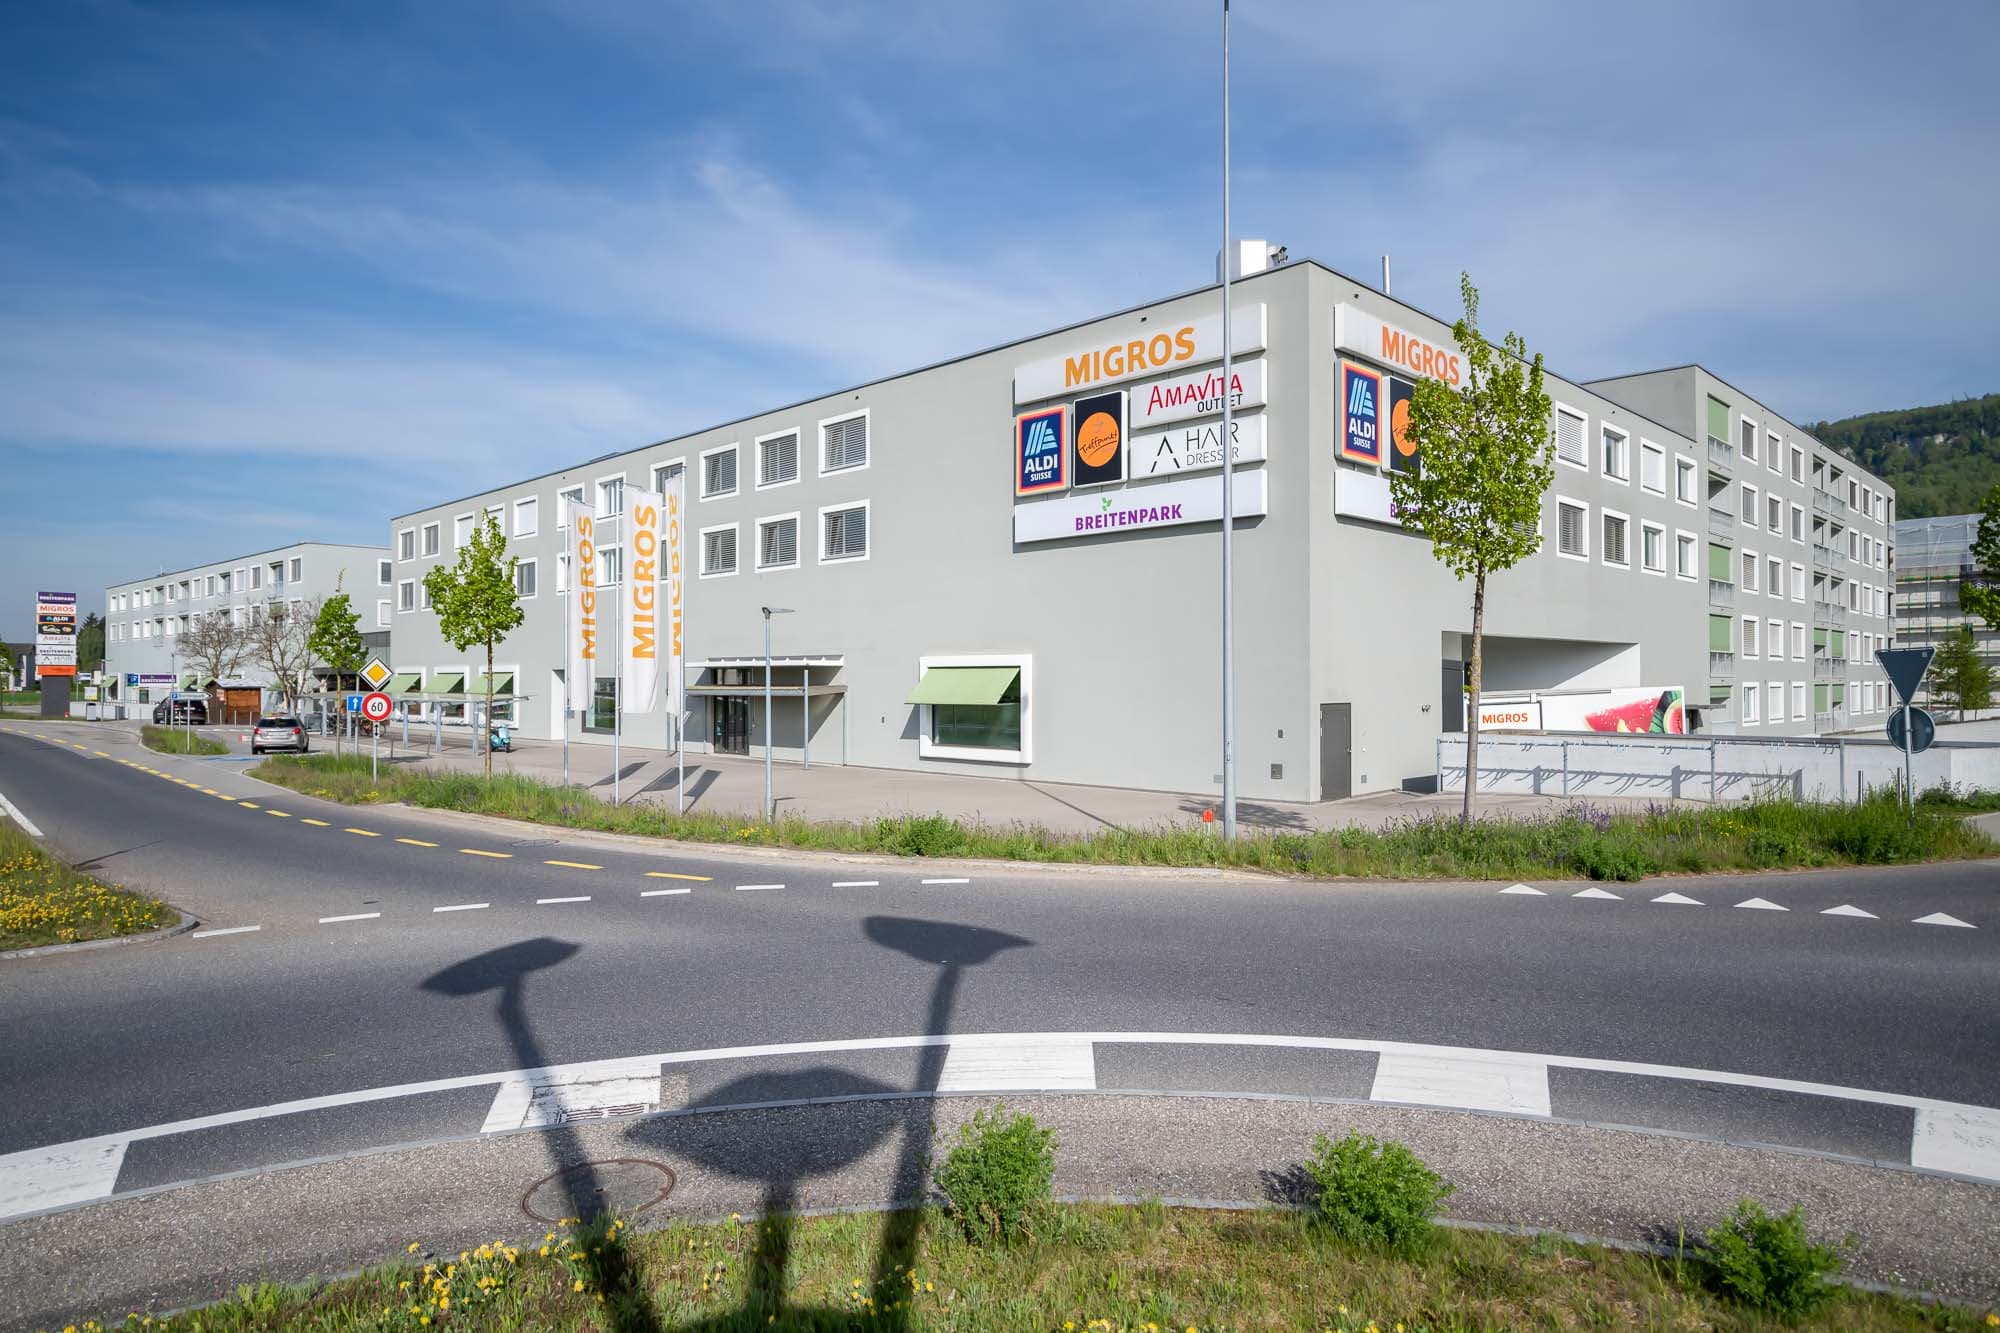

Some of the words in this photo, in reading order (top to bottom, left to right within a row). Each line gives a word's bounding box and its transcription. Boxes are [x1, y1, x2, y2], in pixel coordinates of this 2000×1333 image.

[1064, 326, 1195, 388] MIGROS
[1382, 324, 1460, 386] MIGROS
[1147, 372, 1244, 416] AMAVITA
[1186, 422, 1239, 452] HAIR
[1348, 417, 1376, 441] ALDI
[1353, 436, 1371, 449] SUISSE
[1024, 453, 1058, 474] ALDI
[1186, 446, 1239, 466] DRESSR
[1030, 470, 1053, 482] SUISSE
[1075, 502, 1182, 532] BREITENPARK
[577, 515, 597, 660] MIGROS
[632, 503, 657, 659] MIGROS
[39, 605, 75, 613] MIGROS
[371, 702, 383, 712] 60
[1482, 712, 1528, 724] MIGROS
